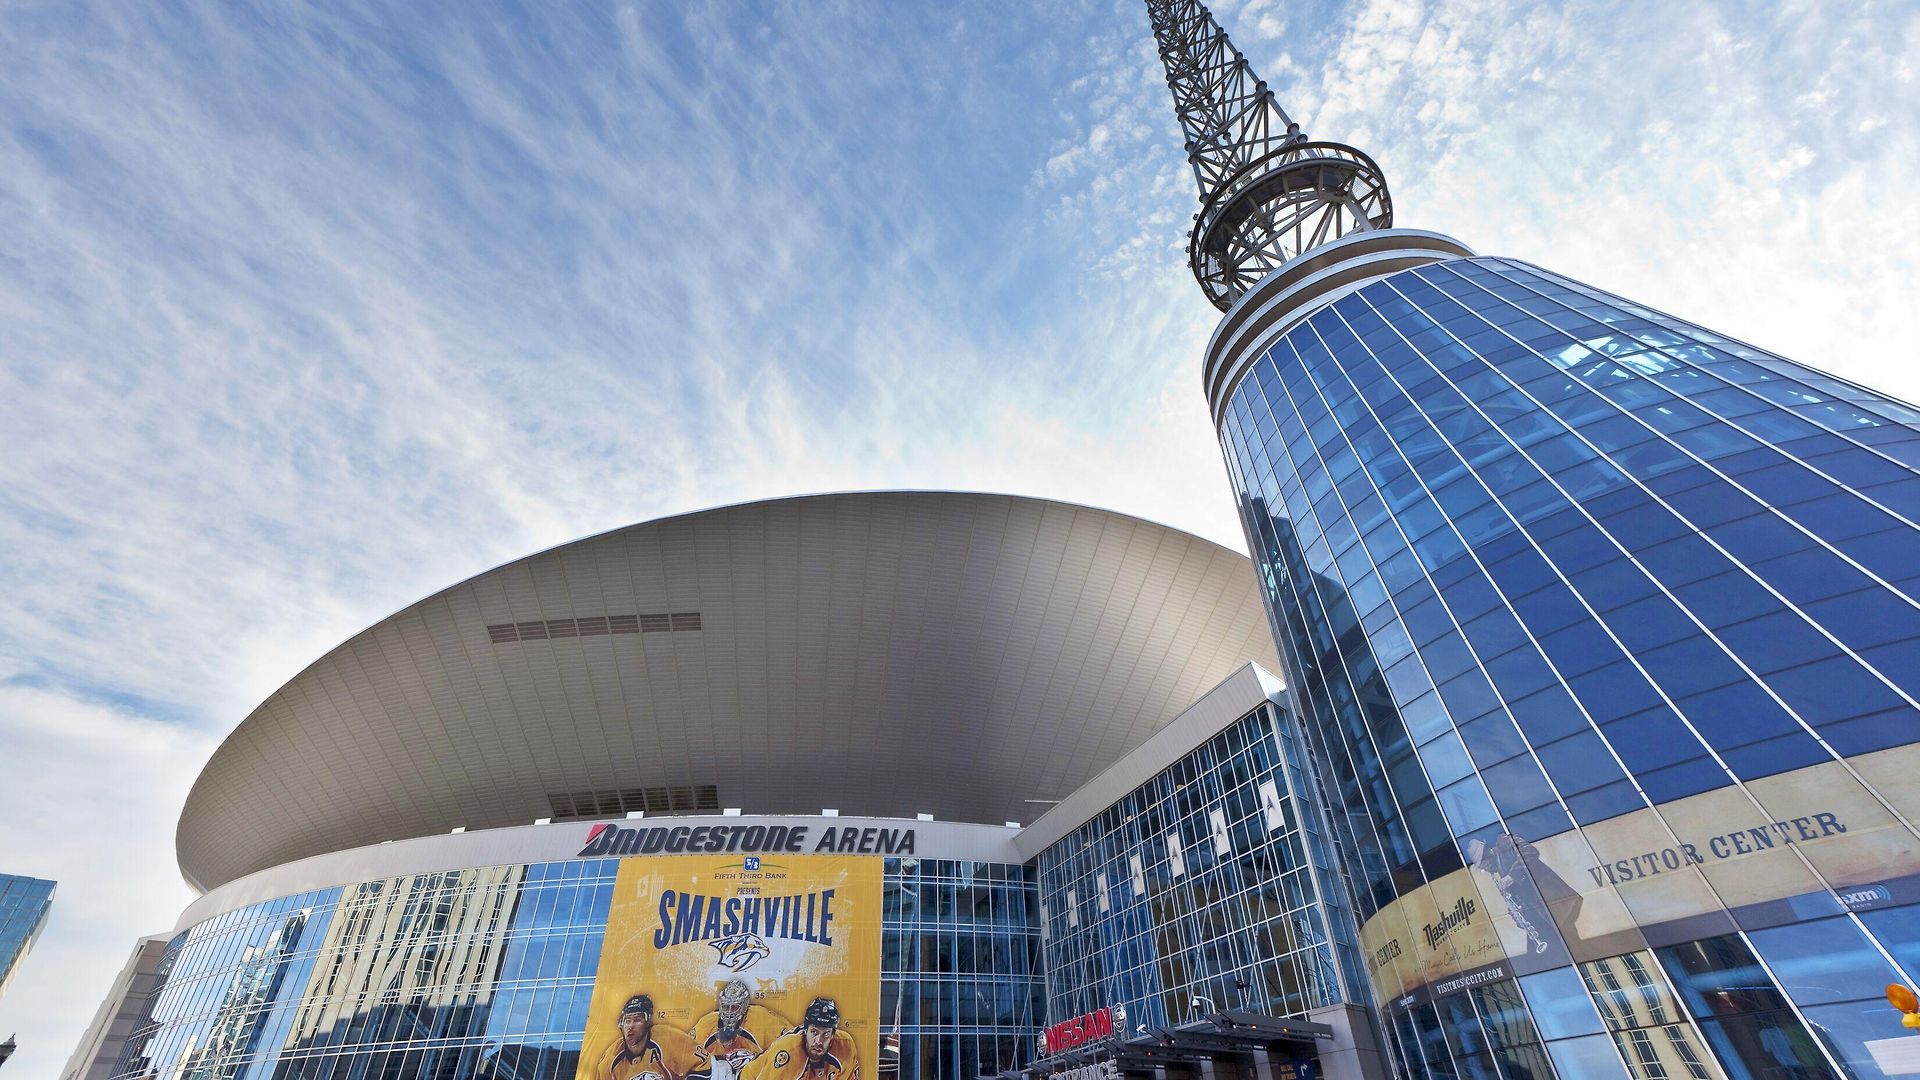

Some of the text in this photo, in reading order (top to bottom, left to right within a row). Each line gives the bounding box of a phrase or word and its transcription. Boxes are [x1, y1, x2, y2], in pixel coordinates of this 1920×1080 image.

[577, 823, 915, 856] BRIDGESTONE ARENA
[1588, 812, 1847, 887] VISITOR CENTER
[736, 887, 761, 895] PRESENTS
[653, 888, 835, 950] SMASHVILLE
[1422, 896, 1476, 951] Nashville
[1436, 967, 1504, 994] VISITMUSCCITY.COM
[1045, 1006, 1113, 1054] NISSAN
